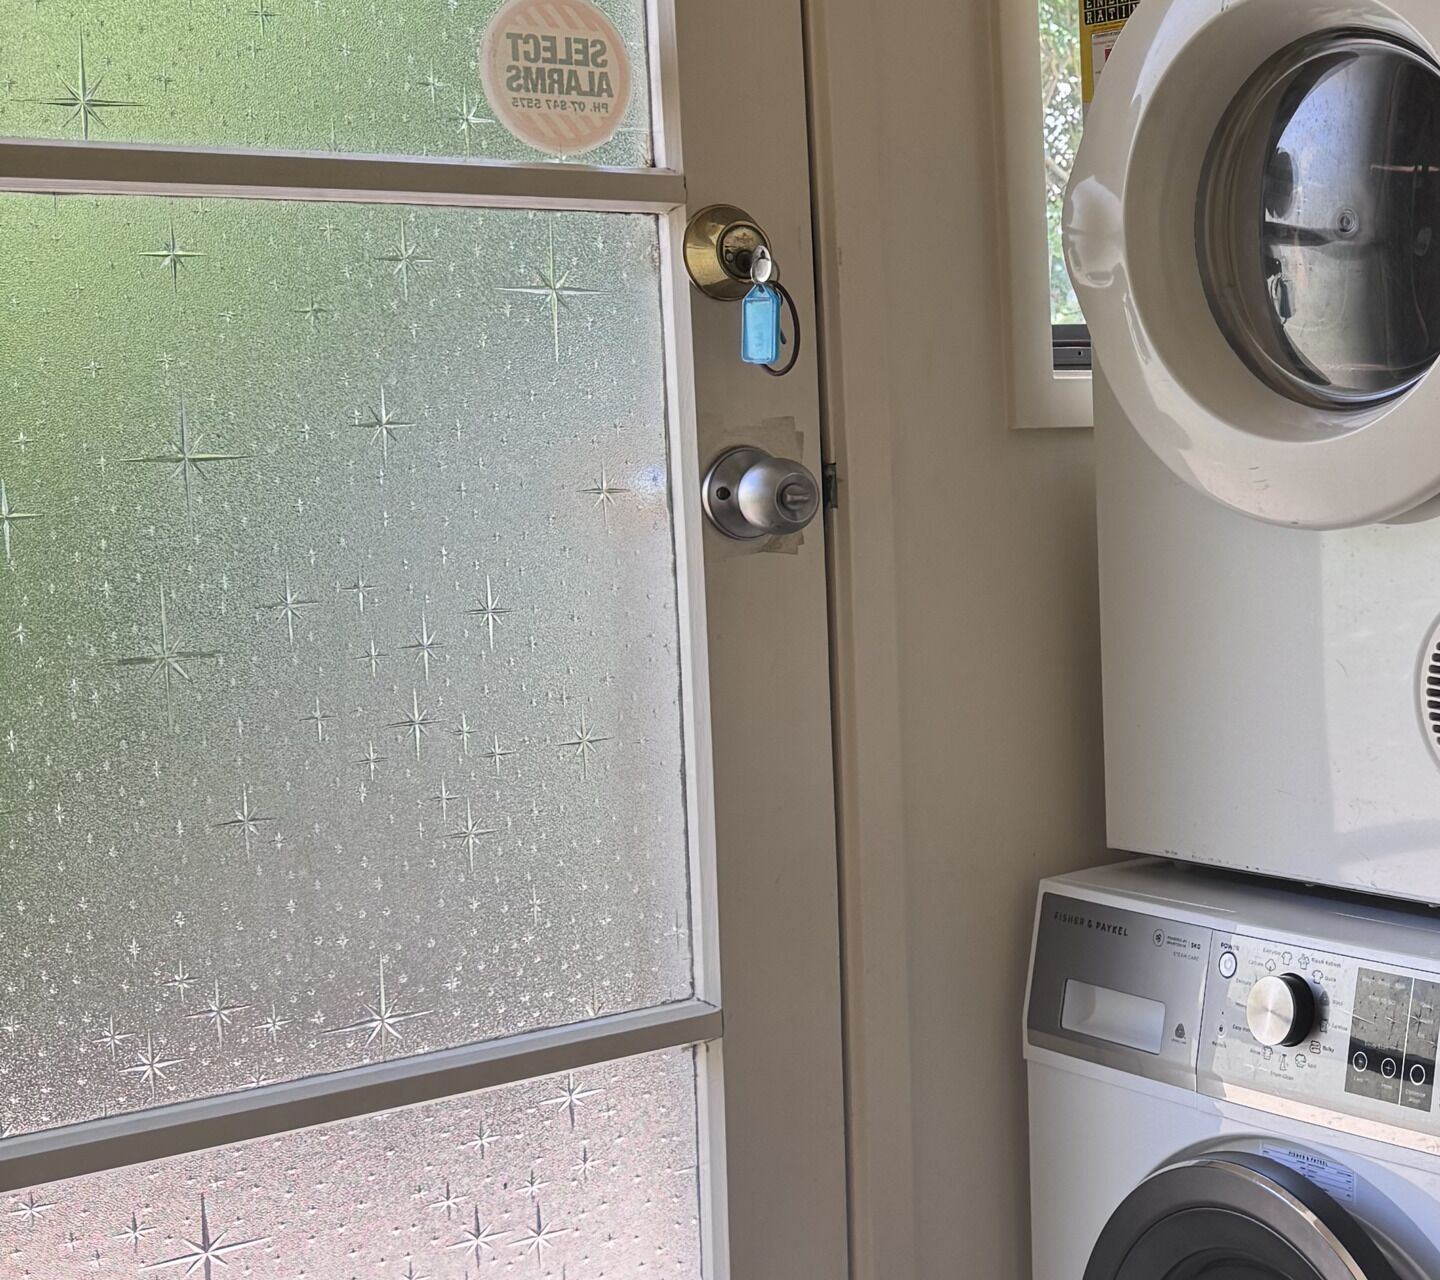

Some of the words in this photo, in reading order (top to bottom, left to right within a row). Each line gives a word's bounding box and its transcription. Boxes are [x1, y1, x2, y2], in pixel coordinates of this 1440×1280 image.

[1086, 3, 1138, 24] RATI
[1054, 911, 1084, 926] FISHER
[1096, 922, 1128, 937] PAYKEL
